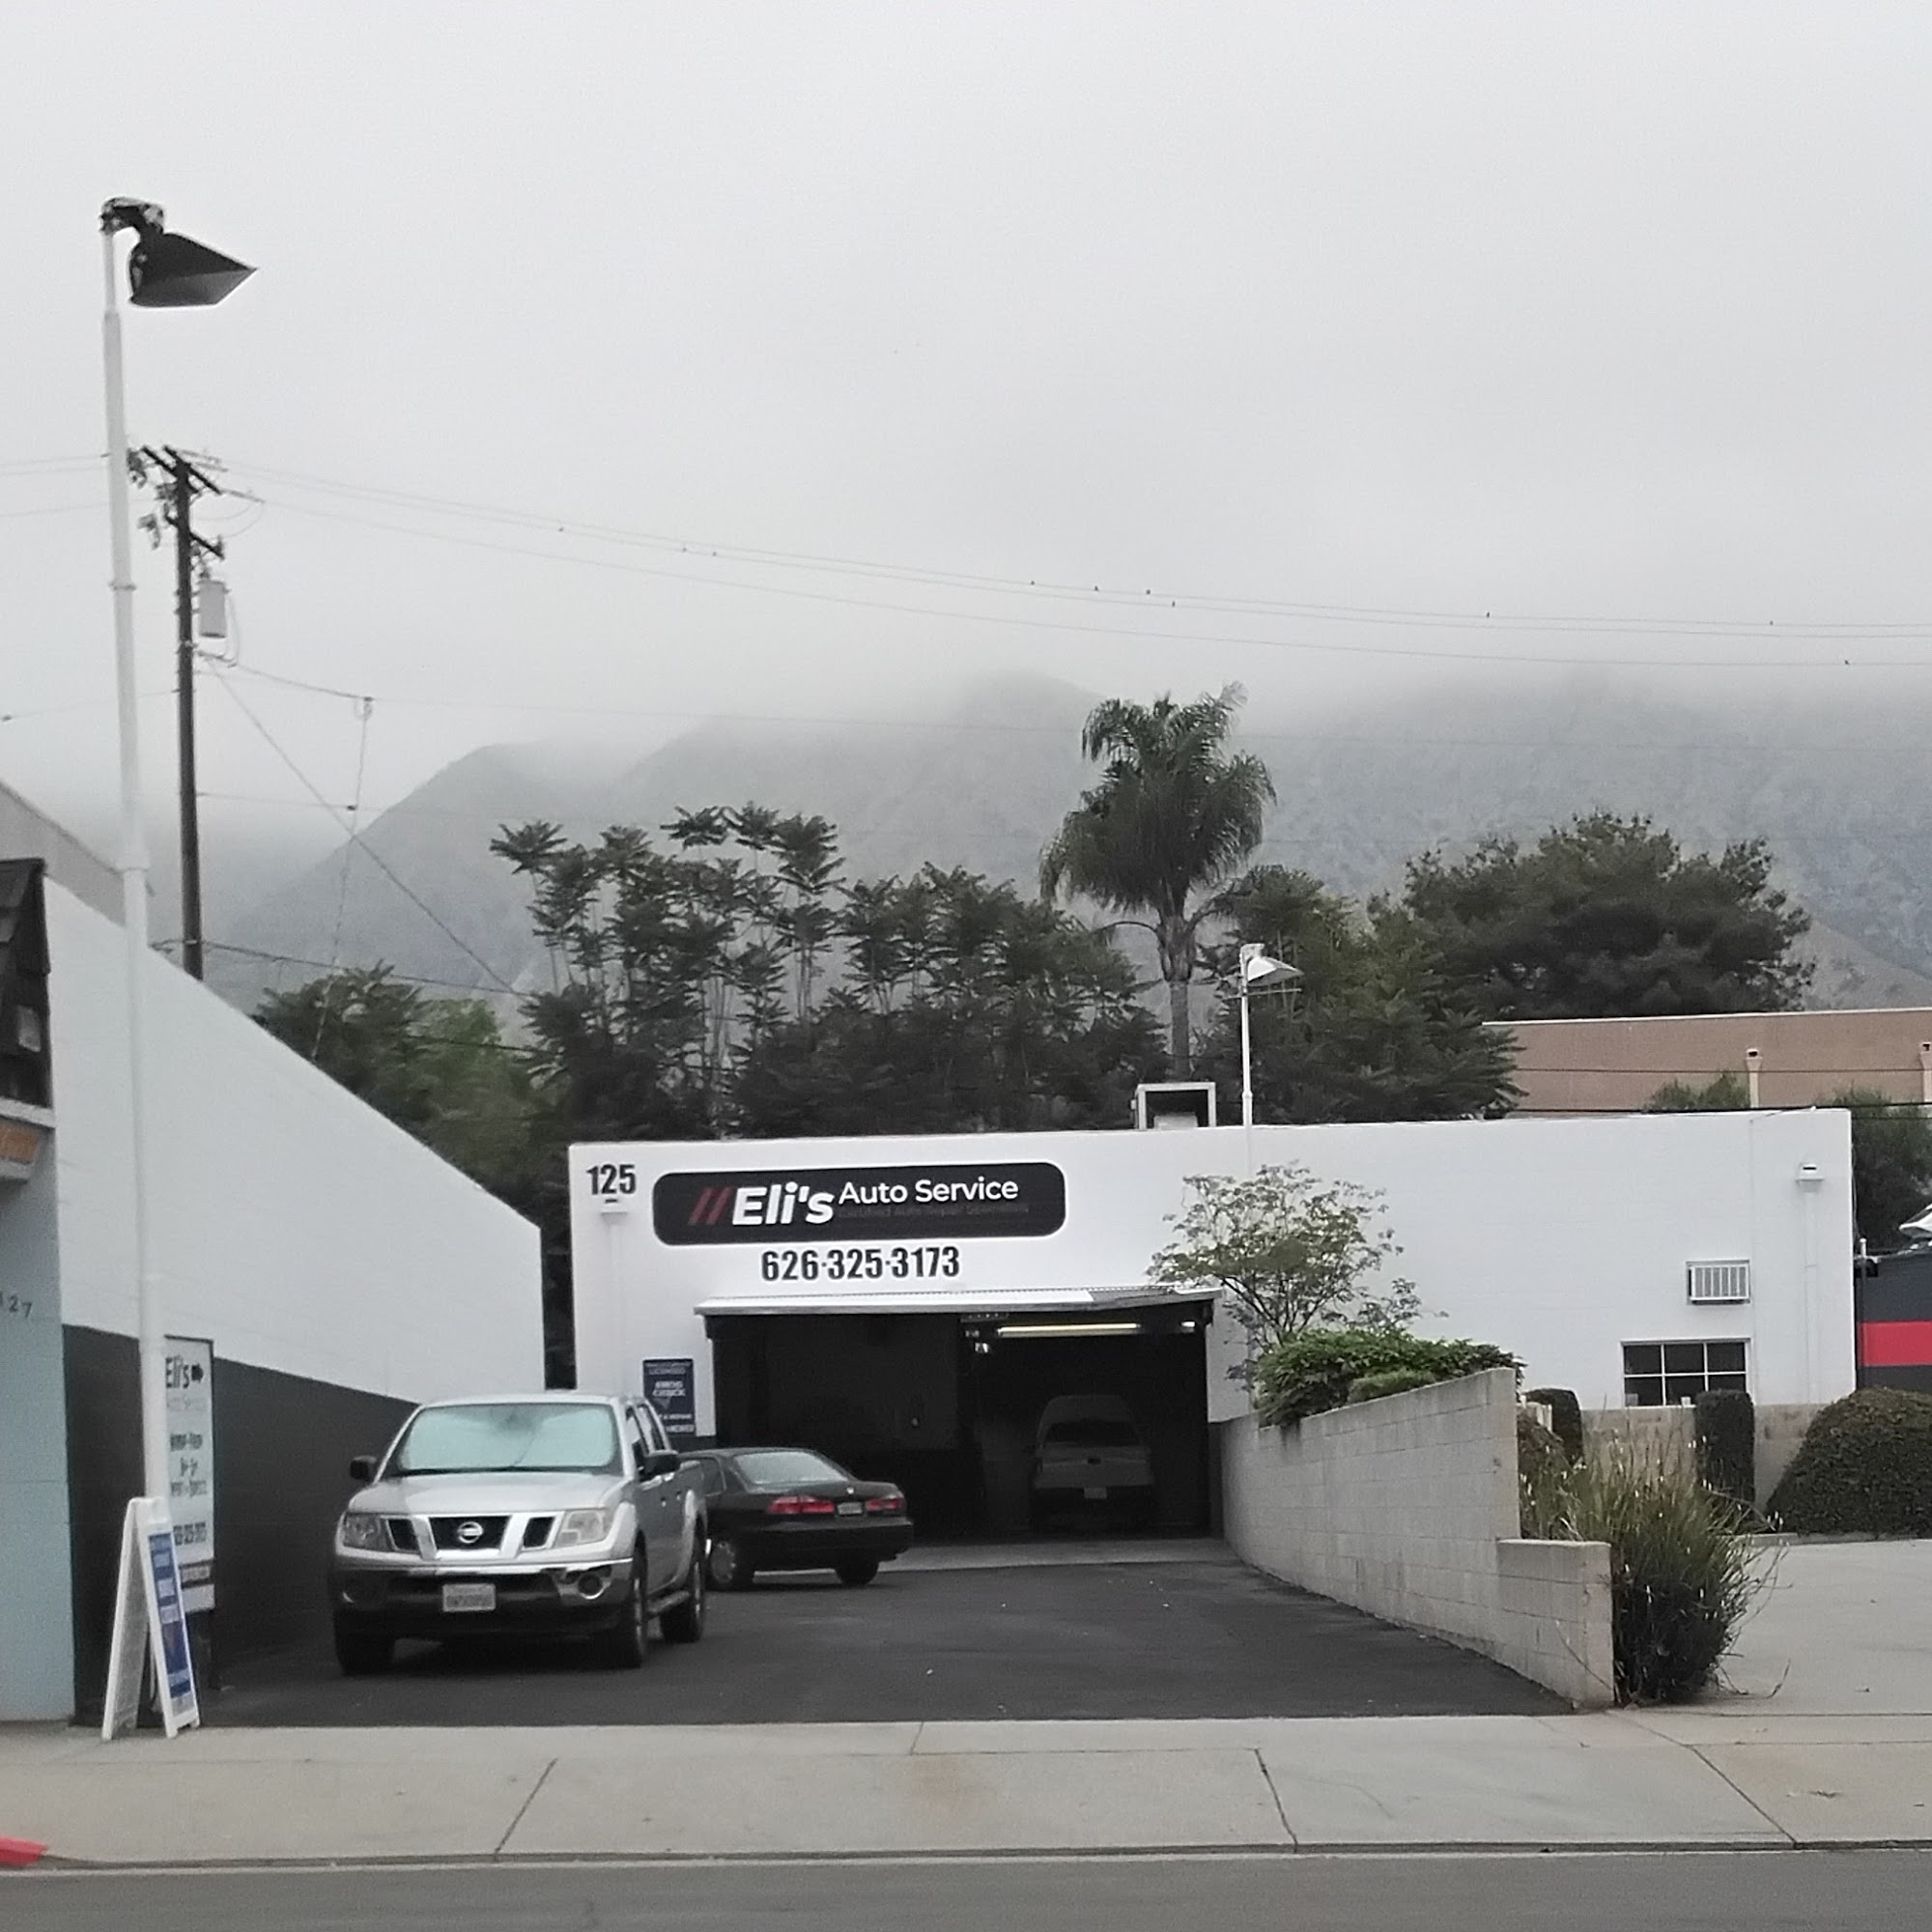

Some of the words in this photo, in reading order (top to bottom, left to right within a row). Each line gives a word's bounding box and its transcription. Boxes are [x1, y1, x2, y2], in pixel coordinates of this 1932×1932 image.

[585, 1163, 637, 1196] 125
[731, 1180, 836, 1226] Eli's
[838, 1181, 909, 1205] Auto
[915, 1176, 1019, 1203] Service
